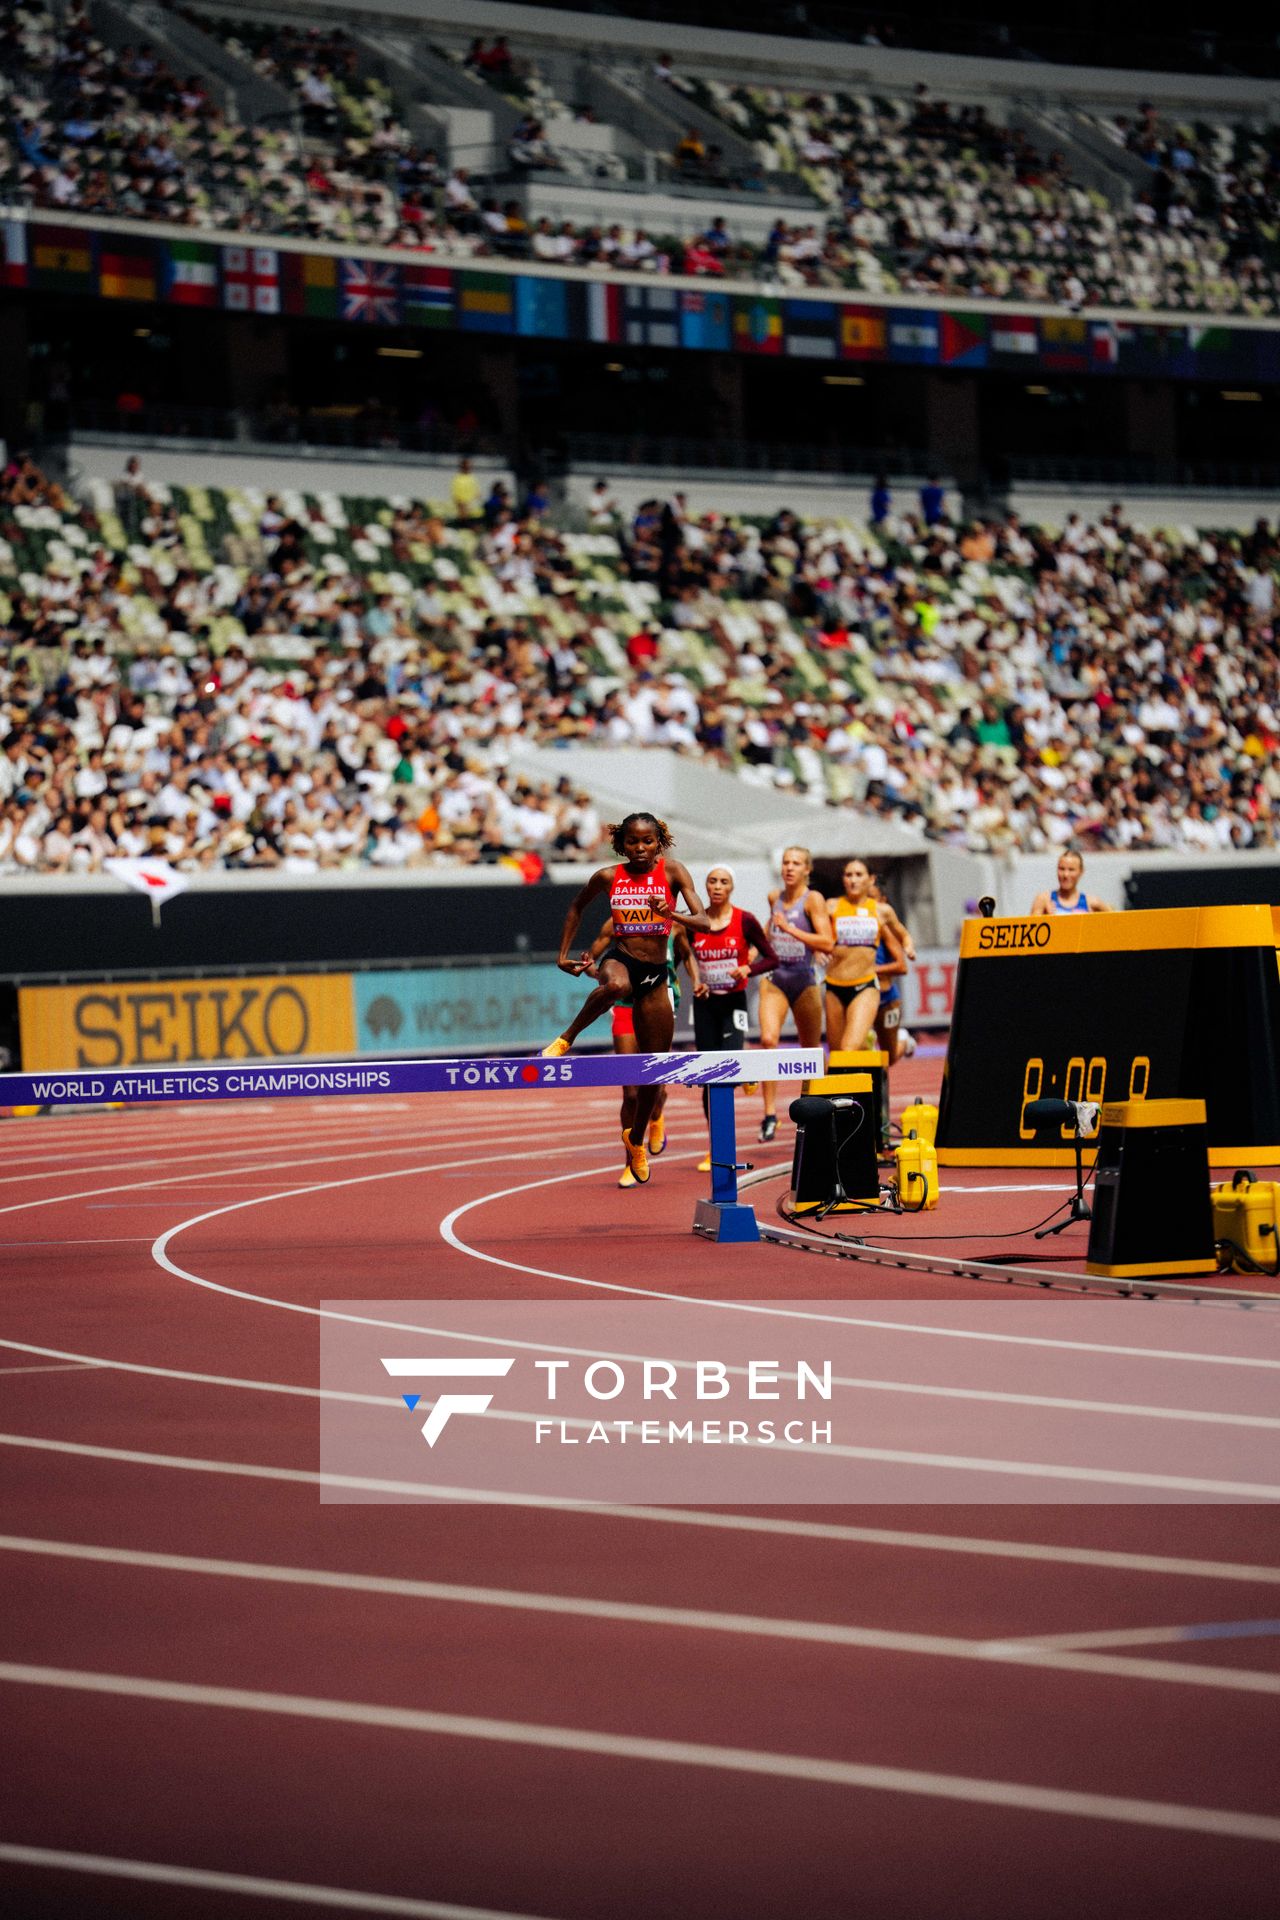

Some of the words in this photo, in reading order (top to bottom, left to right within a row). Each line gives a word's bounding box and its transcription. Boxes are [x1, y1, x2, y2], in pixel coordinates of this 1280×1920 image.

[614, 886, 666, 895] BAHRAIN
[612, 898, 650, 906] HON
[621, 910, 654, 922] YAVI
[979, 922, 1051, 950] SEIKO
[74, 985, 310, 1068] SEIKO
[778, 1062, 817, 1075] NISHI
[32, 1081, 105, 1099] WORLD
[112, 1077, 219, 1096] ATHLETICS
[225, 1071, 390, 1092] CHAMPIONSHIPS
